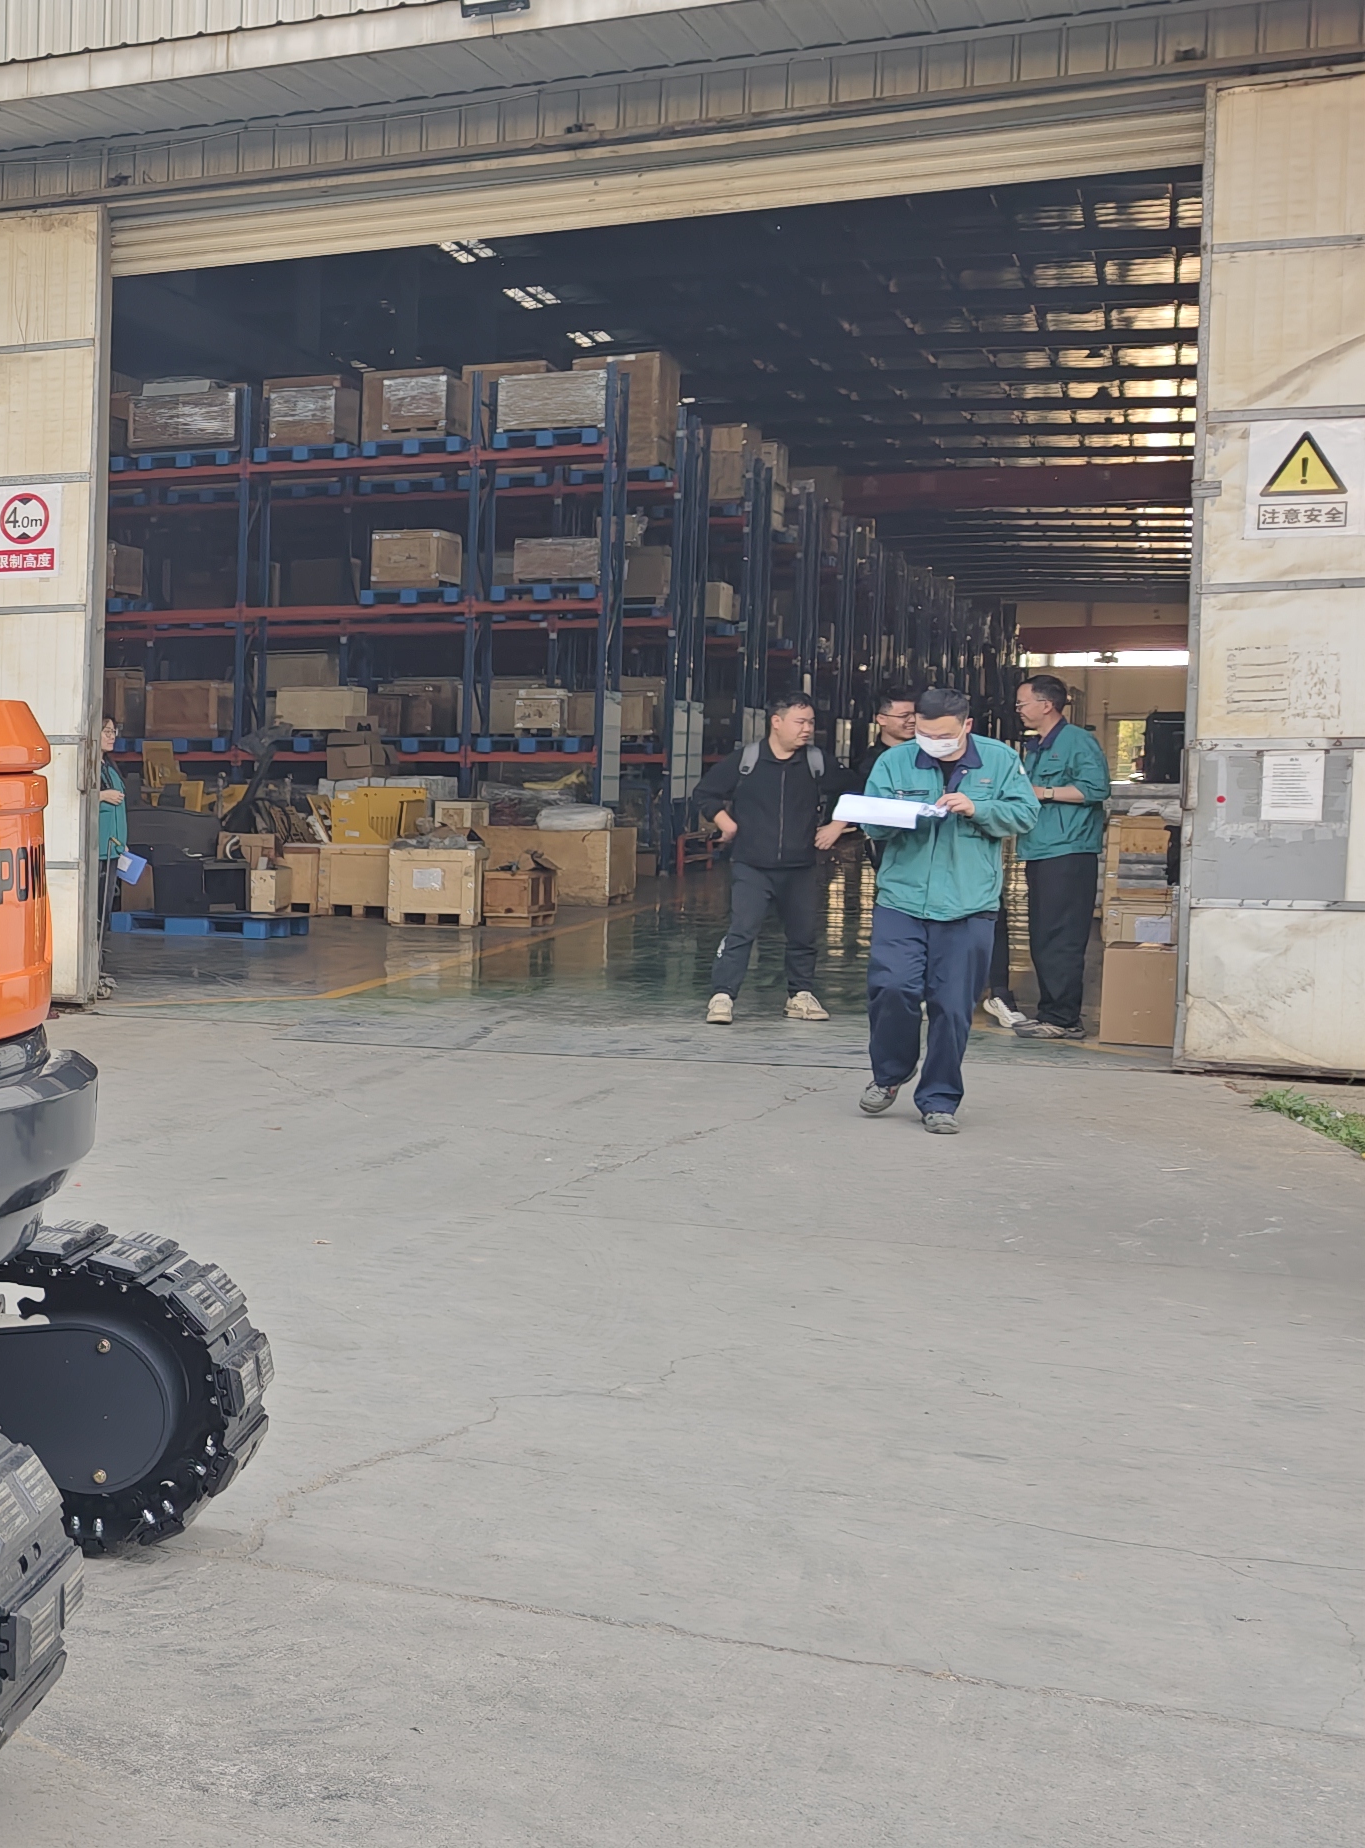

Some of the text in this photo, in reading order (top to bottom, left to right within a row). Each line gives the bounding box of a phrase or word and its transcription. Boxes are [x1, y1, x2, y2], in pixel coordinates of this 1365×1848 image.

[5, 506, 44, 529] 4.0m
[1261, 507, 1344, 525] 注意安全
